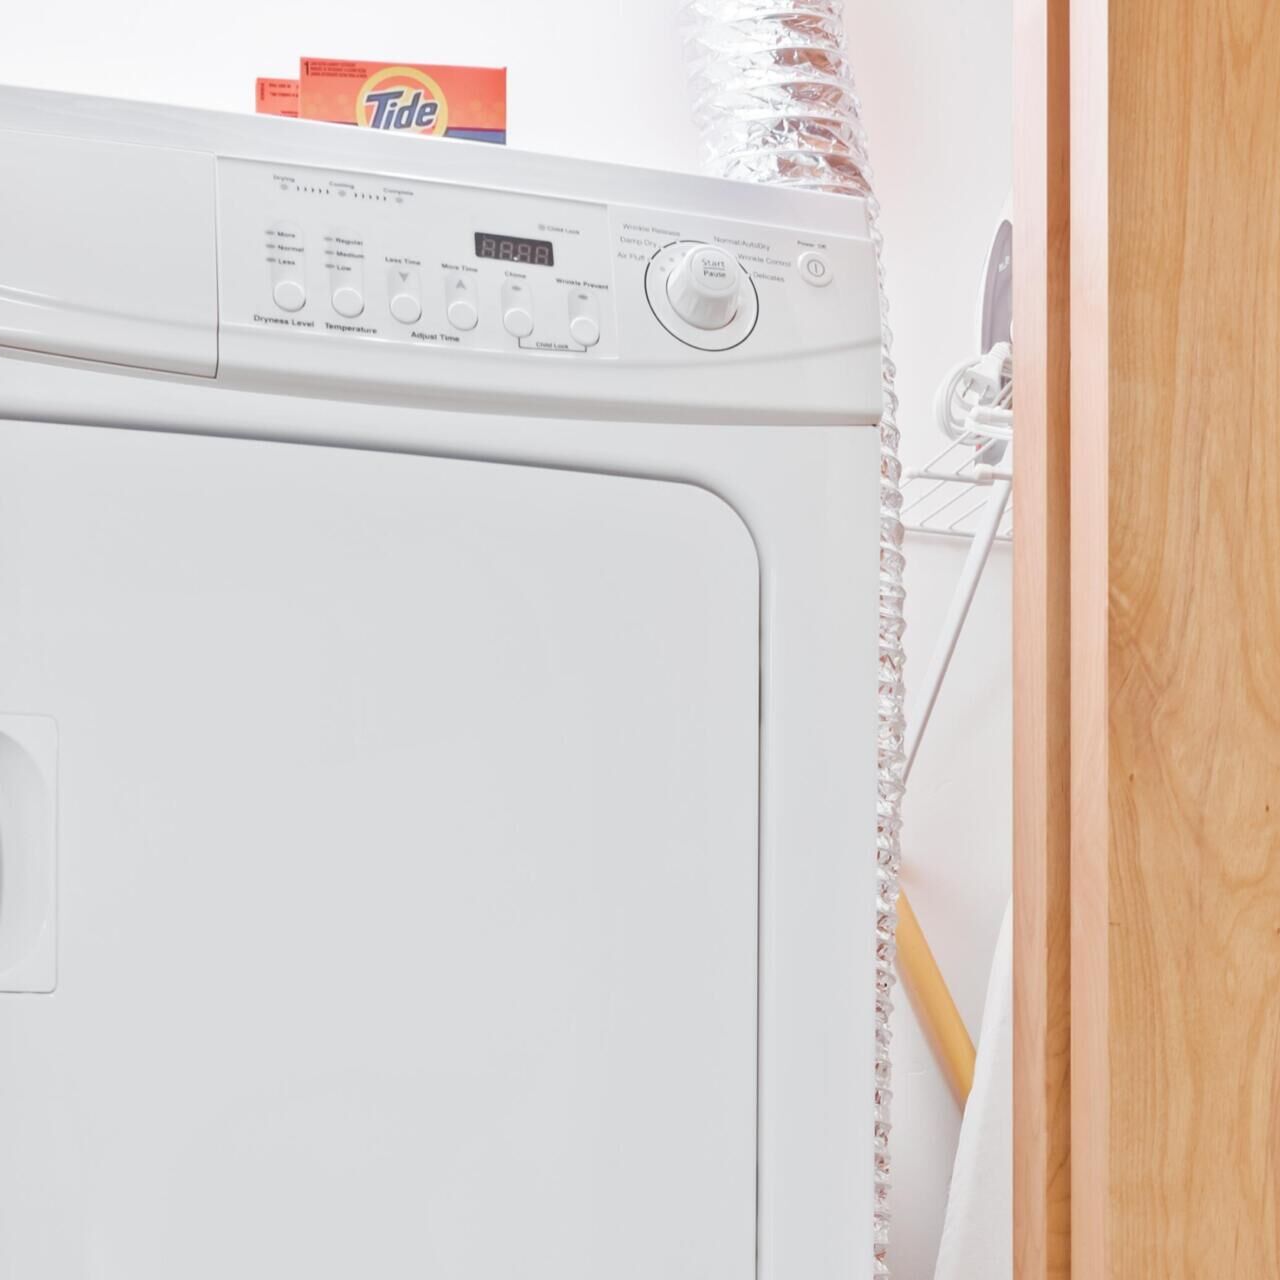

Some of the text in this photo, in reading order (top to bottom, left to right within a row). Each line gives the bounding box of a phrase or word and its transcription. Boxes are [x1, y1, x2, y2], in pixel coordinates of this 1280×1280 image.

[364, 89, 439, 131] Tide
[277, 230, 296, 239] More
[335, 237, 363, 247] Regular
[620, 236, 657, 248] Damp Dry
[277, 244, 305, 253] Normal
[336, 251, 365, 260] Medium
[385, 255, 421, 266] Less Time
[278, 258, 296, 266] Less
[701, 258, 725, 268] Start
[337, 264, 352, 272] Low
[441, 262, 478, 273] More Time
[703, 269, 726, 278] Pause
[753, 271, 785, 282] Delicates
[556, 277, 609, 290] Wrinkle Prevent
[253, 314, 315, 328] Dryness Level
[325, 321, 378, 335] Temperature
[411, 330, 460, 342] Adjust Time
[535, 341, 569, 350] Child Lock
